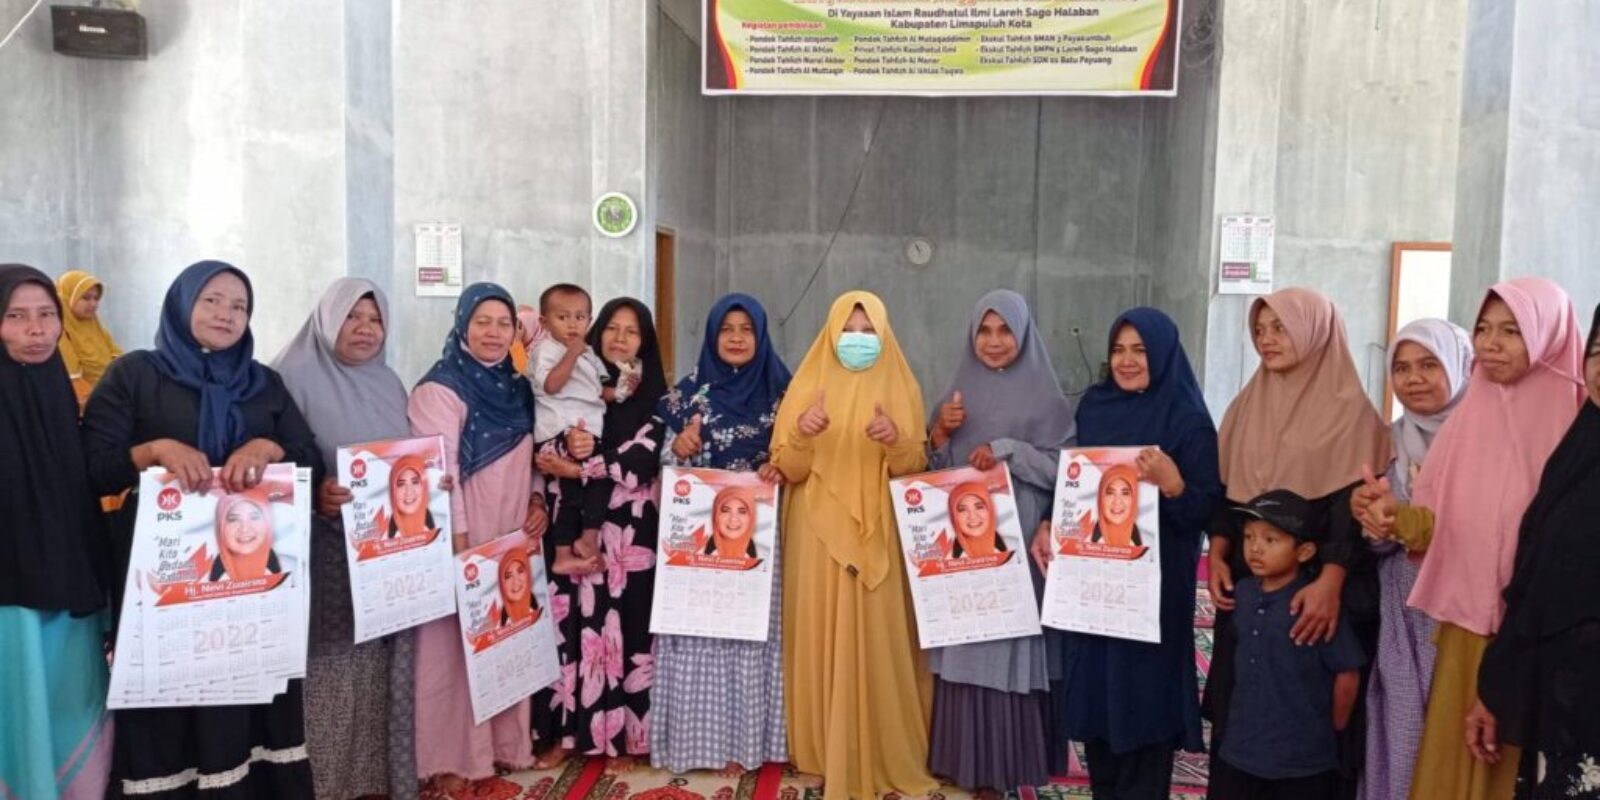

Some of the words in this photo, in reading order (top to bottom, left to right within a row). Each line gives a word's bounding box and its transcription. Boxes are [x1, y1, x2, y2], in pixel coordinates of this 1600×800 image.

[827, 9, 838, 17] Di
[840, 9, 881, 20] Yayasan
[884, 8, 911, 17] Islam
[914, 8, 968, 17] Raudhatul
[970, 8, 990, 17] Ilmi
[993, 8, 1023, 17] Lareh
[1025, 8, 1051, 19] Sago
[1054, 7, 1099, 16] Halaban
[891, 20, 947, 30] Kabupaten
[950, 20, 1006, 30] Limapuluh
[1008, 19, 1032, 28] Kota
[1085, 45, 1103, 54] Sago
[1105, 44, 1138, 52] Halaban
[351, 479, 368, 489] PKS
[1065, 480, 1080, 489] PKS
[673, 497, 690, 505] PKS
[907, 506, 925, 514] PKS
[157, 512, 183, 521] PKS
[383, 574, 427, 601] 2022
[687, 590, 735, 608] 2022
[1080, 583, 1126, 604] 2022
[951, 593, 999, 616] 2022
[193, 623, 259, 652] 2022
